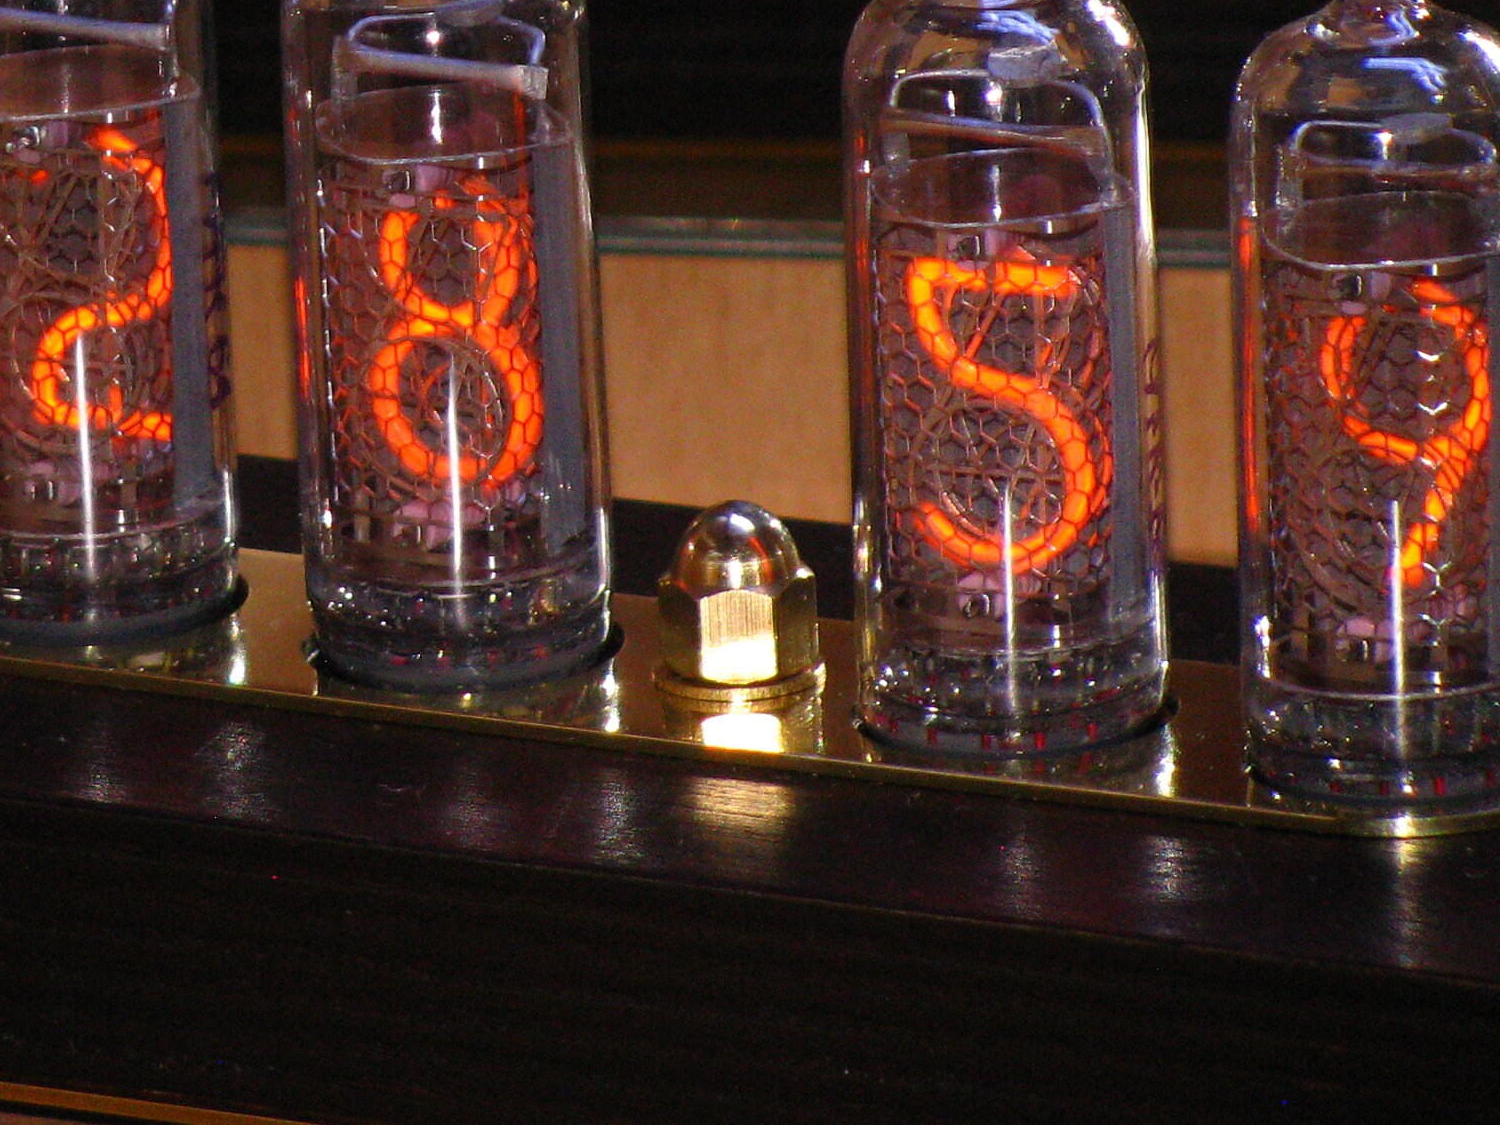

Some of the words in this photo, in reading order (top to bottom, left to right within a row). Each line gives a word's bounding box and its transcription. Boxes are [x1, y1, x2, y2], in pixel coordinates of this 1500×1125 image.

[29, 127, 173, 442] 2
[366, 178, 544, 491] 8
[904, 258, 1097, 575] 5
[1318, 278, 1492, 587] 9
